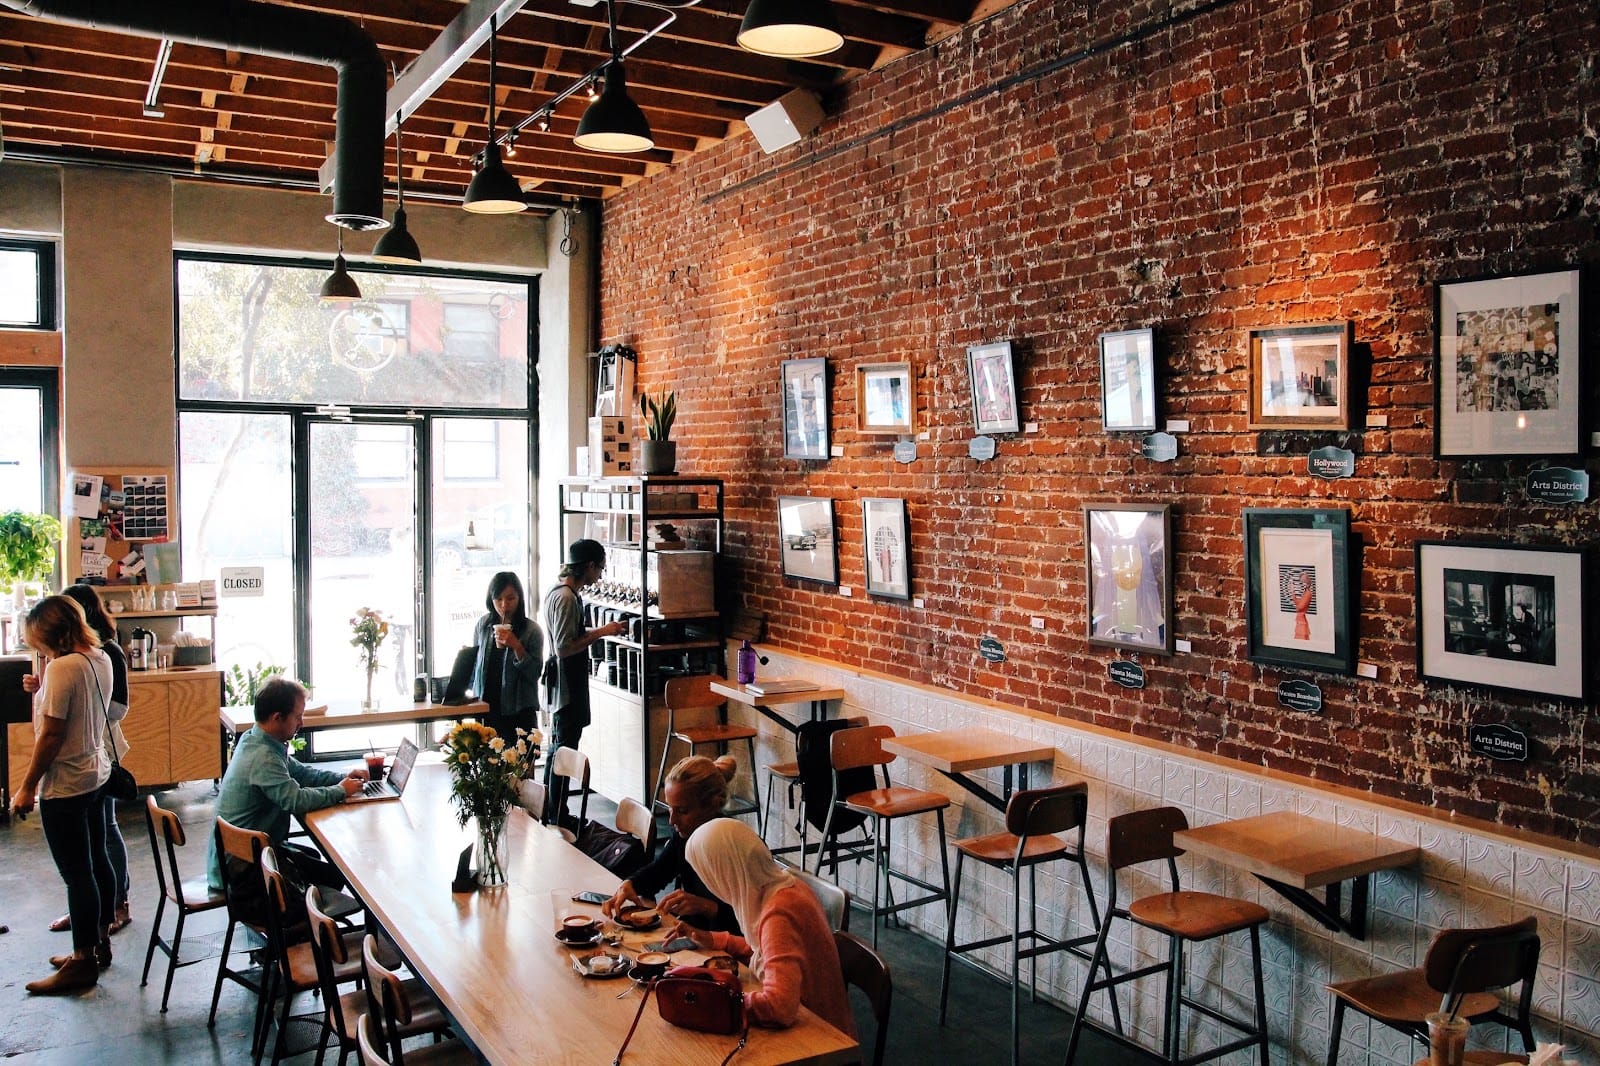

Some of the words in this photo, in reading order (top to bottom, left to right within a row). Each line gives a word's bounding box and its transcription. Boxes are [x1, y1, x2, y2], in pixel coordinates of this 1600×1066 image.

[1313, 458, 1348, 468] Hollywood
[1531, 480, 1550, 489] Arts
[1552, 481, 1583, 490] District
[224, 578, 261, 589] CLOSED
[1474, 734, 1493, 745] Arts
[1494, 737, 1523, 751] District
